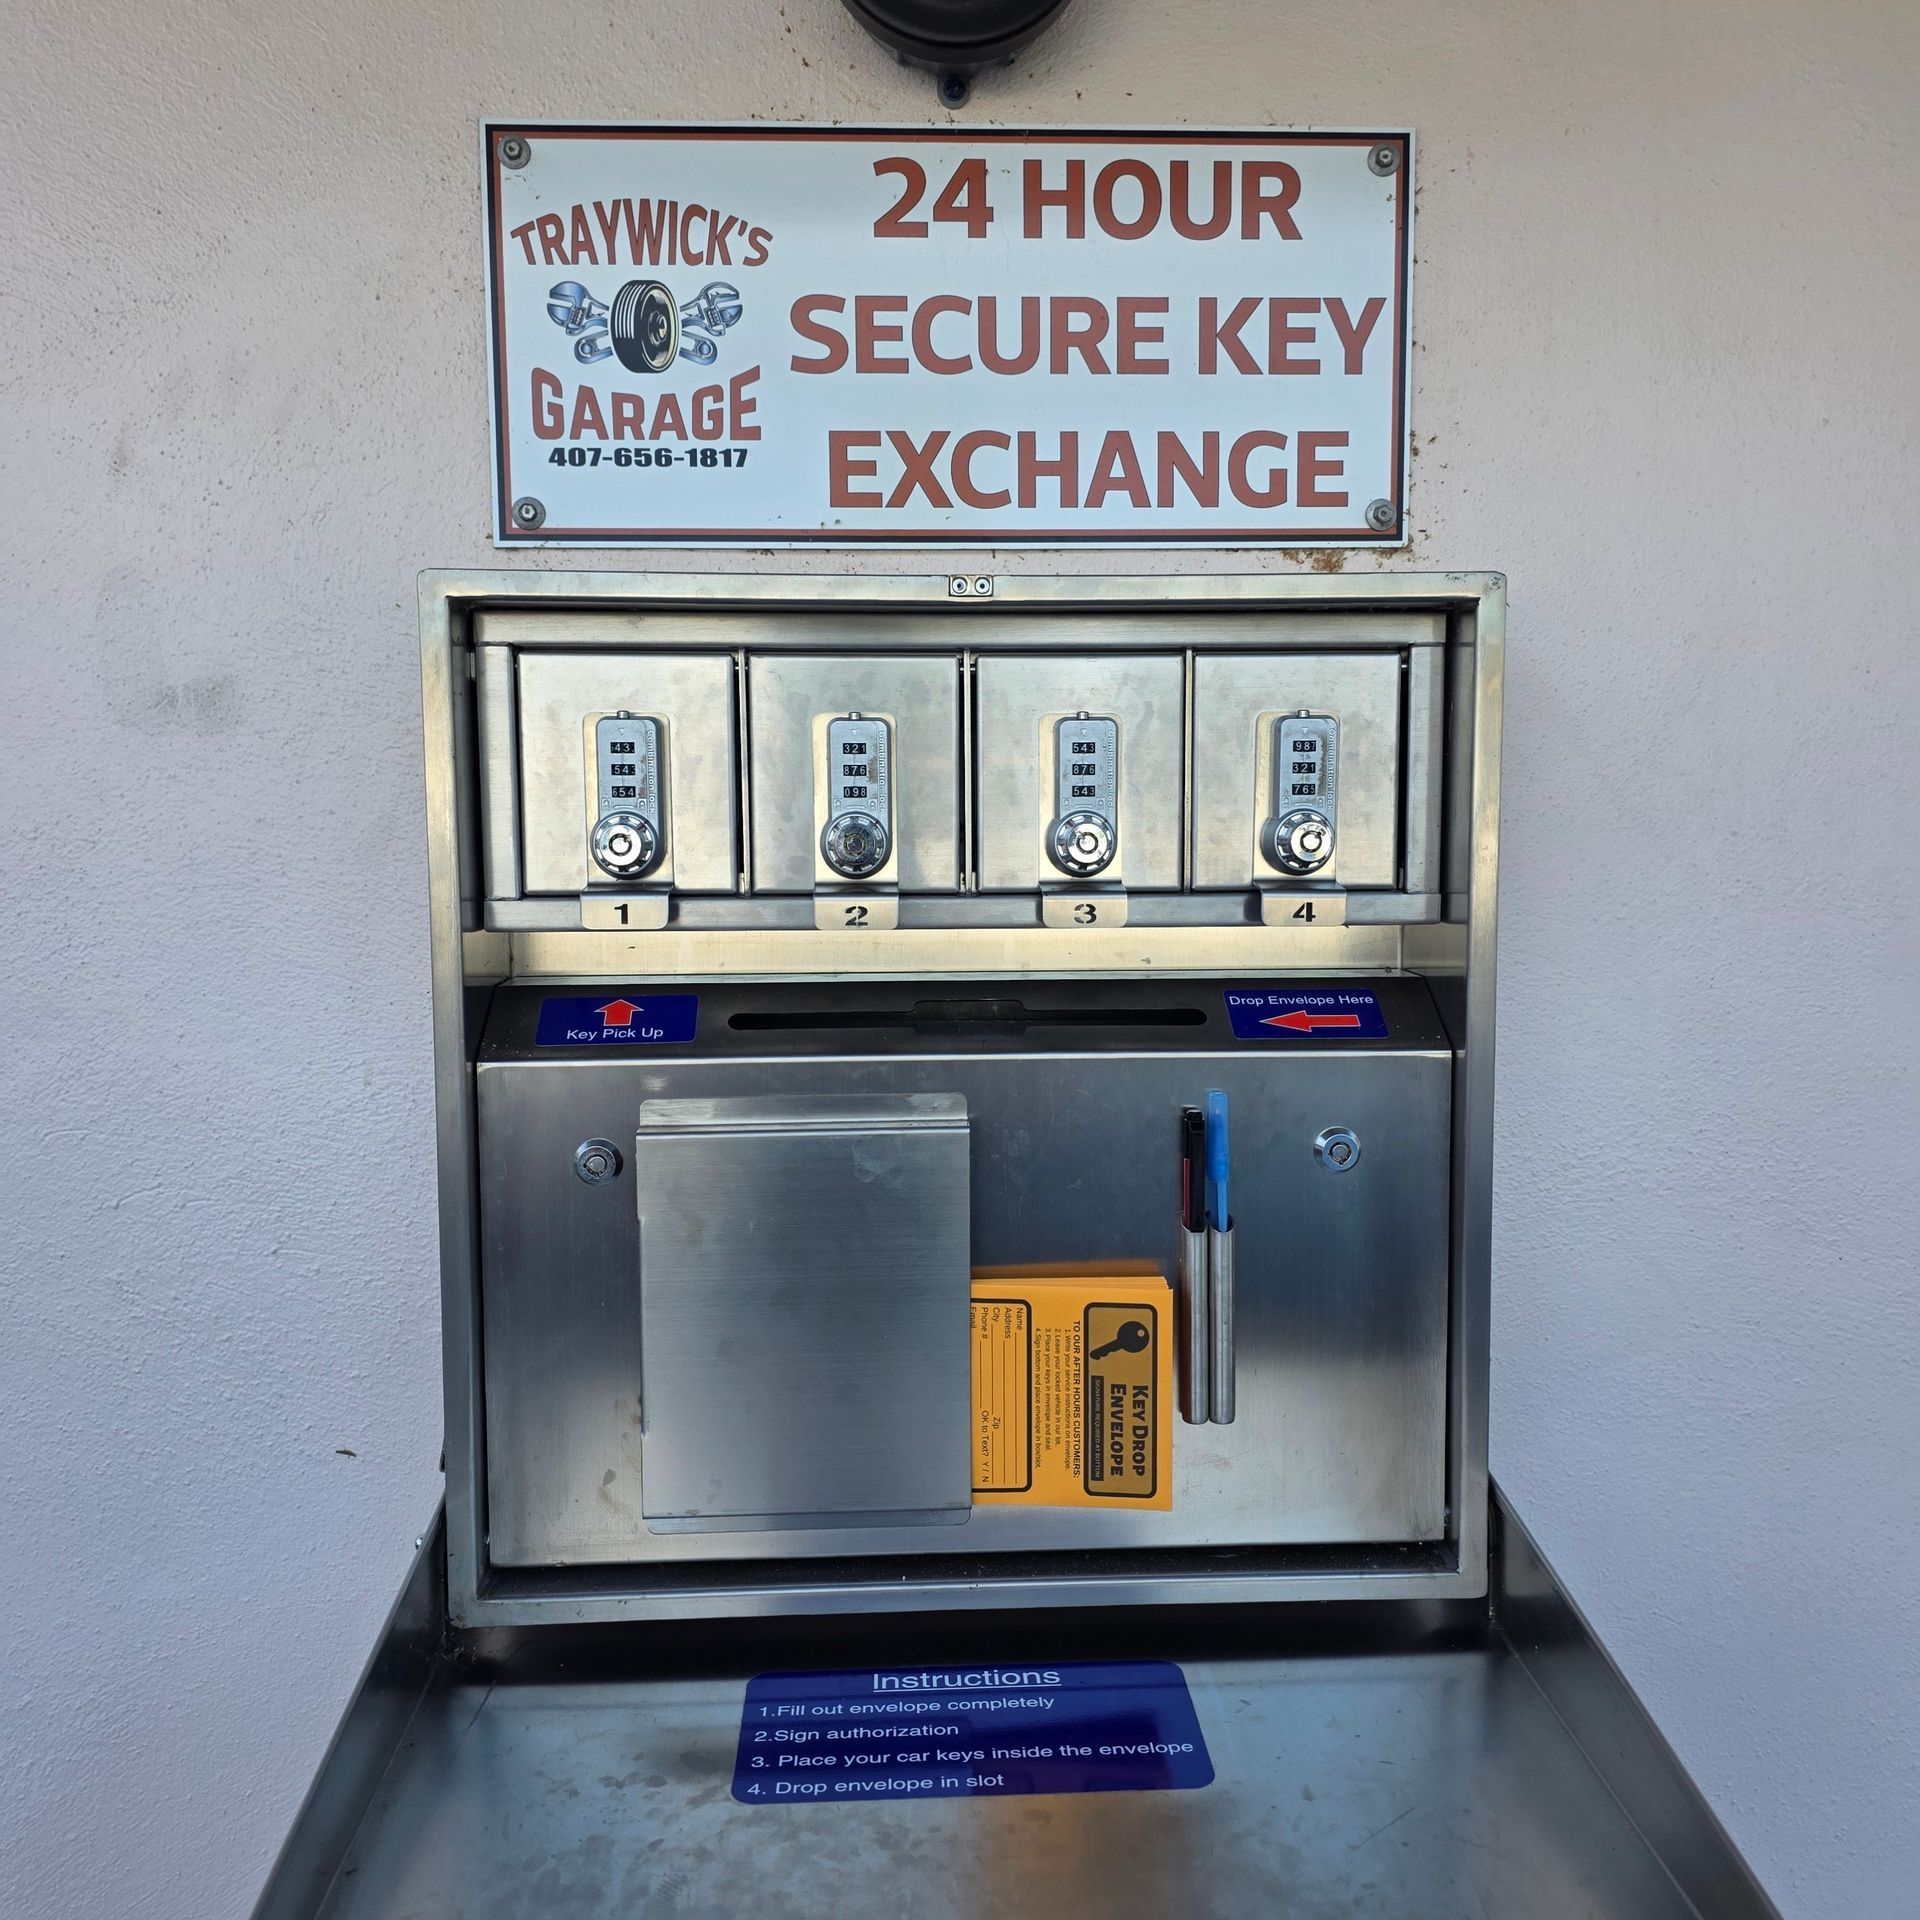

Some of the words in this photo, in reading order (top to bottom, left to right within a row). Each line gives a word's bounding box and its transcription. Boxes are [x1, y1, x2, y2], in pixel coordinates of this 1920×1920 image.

[873, 157, 994, 238] 24
[1023, 159, 1303, 240] HOUR
[510, 198, 773, 266] TRAYWICK'S
[790, 294, 1169, 375] SECURE
[1199, 297, 1387, 375] KEY
[531, 365, 761, 440] GARAGE
[549, 447, 748, 467] 407-656-1817
[829, 430, 1349, 508] EXCHANGE
[844, 744, 866, 753] 321
[1073, 743, 1095, 752] 543
[1295, 741, 1315, 751] 987
[647, 729, 655, 791] Combination
[878, 730, 886, 791] Combination
[844, 765, 866, 775] 876
[1073, 765, 1095, 774] 876
[1293, 763, 1315, 773] 321
[612, 787, 634, 797] 654
[845, 787, 867, 797] 098
[1073, 787, 1095, 796] 543
[1294, 784, 1315, 794] 765
[614, 903, 629, 925] 1
[845, 905, 869, 926] 2
[1074, 903, 1097, 924] 3
[1292, 902, 1316, 922] 4
[1229, 996, 1264, 1007] Drop
[1268, 995, 1335, 1006] Envelope
[1339, 995, 1374, 1004] Here
[567, 1030, 597, 1041] Key
[603, 1028, 636, 1038] Pick
[642, 1028, 663, 1039] Up
[992, 1307, 1000, 1322] City
[1074, 1320, 1080, 1332] TO
[982, 1411, 988, 1423] OK
[992, 1417, 1000, 1429] Zip
[982, 1425, 988, 1433] to
[873, 1668, 1061, 1690] Instructions
[812, 1704, 843, 1715] out
[849, 1700, 941, 1716] envelope
[947, 1696, 1055, 1711] completely
[826, 1723, 959, 1739] authorization
[751, 1756, 770, 1768] 3.
[778, 1754, 837, 1767] Place
[843, 1753, 891, 1767] your
[897, 1750, 930, 1762] car
[936, 1747, 985, 1764] keys
[992, 1744, 1053, 1759] inside
[1059, 1743, 1092, 1757] the
[1099, 1740, 1194, 1757] envelope
[747, 1782, 767, 1795] 4.
[775, 1782, 827, 1796] Drop
[834, 1777, 935, 1794] envelope
[941, 1775, 960, 1788] in
[965, 1773, 1004, 1788] slot
